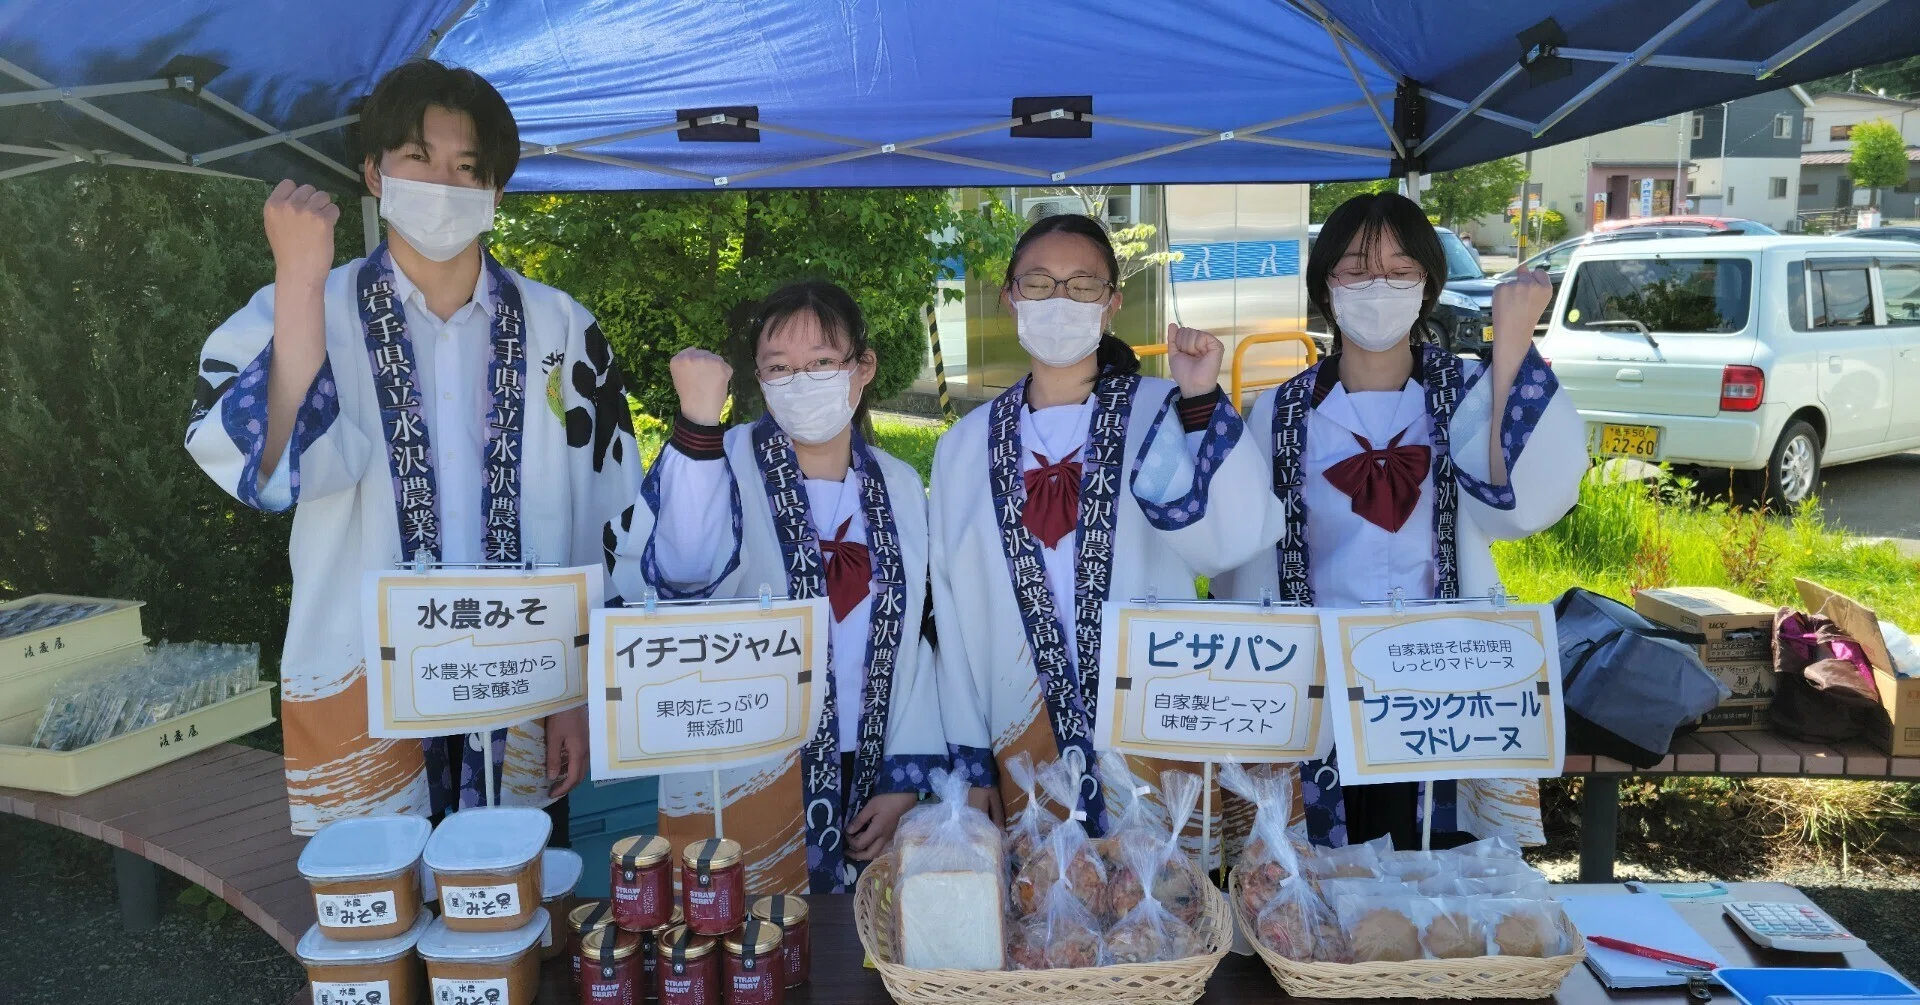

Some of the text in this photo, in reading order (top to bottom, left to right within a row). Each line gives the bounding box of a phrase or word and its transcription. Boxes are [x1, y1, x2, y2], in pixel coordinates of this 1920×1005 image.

[485, 302, 524, 569] 岩手県立水沢農業
[992, 392, 1086, 741] 岩手県立水沢農業高等学校
[417, 597, 547, 630] 水農みそ
[616, 630, 802, 669] イチゴジャム
[848, 477, 904, 816] 岩手県立水沢農業高等学
[1148, 631, 1298, 672] ピザパン
[1388, 639, 1513, 657] 自家栽培そば粉使用
[420, 655, 557, 681] 水農米で麹から
[1391, 656, 1516, 673] しっとりマドレーヌ
[452, 679, 530, 701] 自家醸造
[655, 692, 770, 719] 果肉たっぷり
[1154, 692, 1287, 715] 自家製ピーマン
[1362, 690, 1542, 724] ブラックホール
[686, 718, 743, 738] 無添加
[1161, 714, 1274, 735] 味噌テイスト
[1399, 726, 1523, 756] マドレーヌ
[615, 886, 641, 894] STRAW
[340, 909, 371, 924] みそ
[465, 901, 496, 915] みそ
[665, 979, 691, 987] STRAW
[733, 975, 760, 983] STRAW
